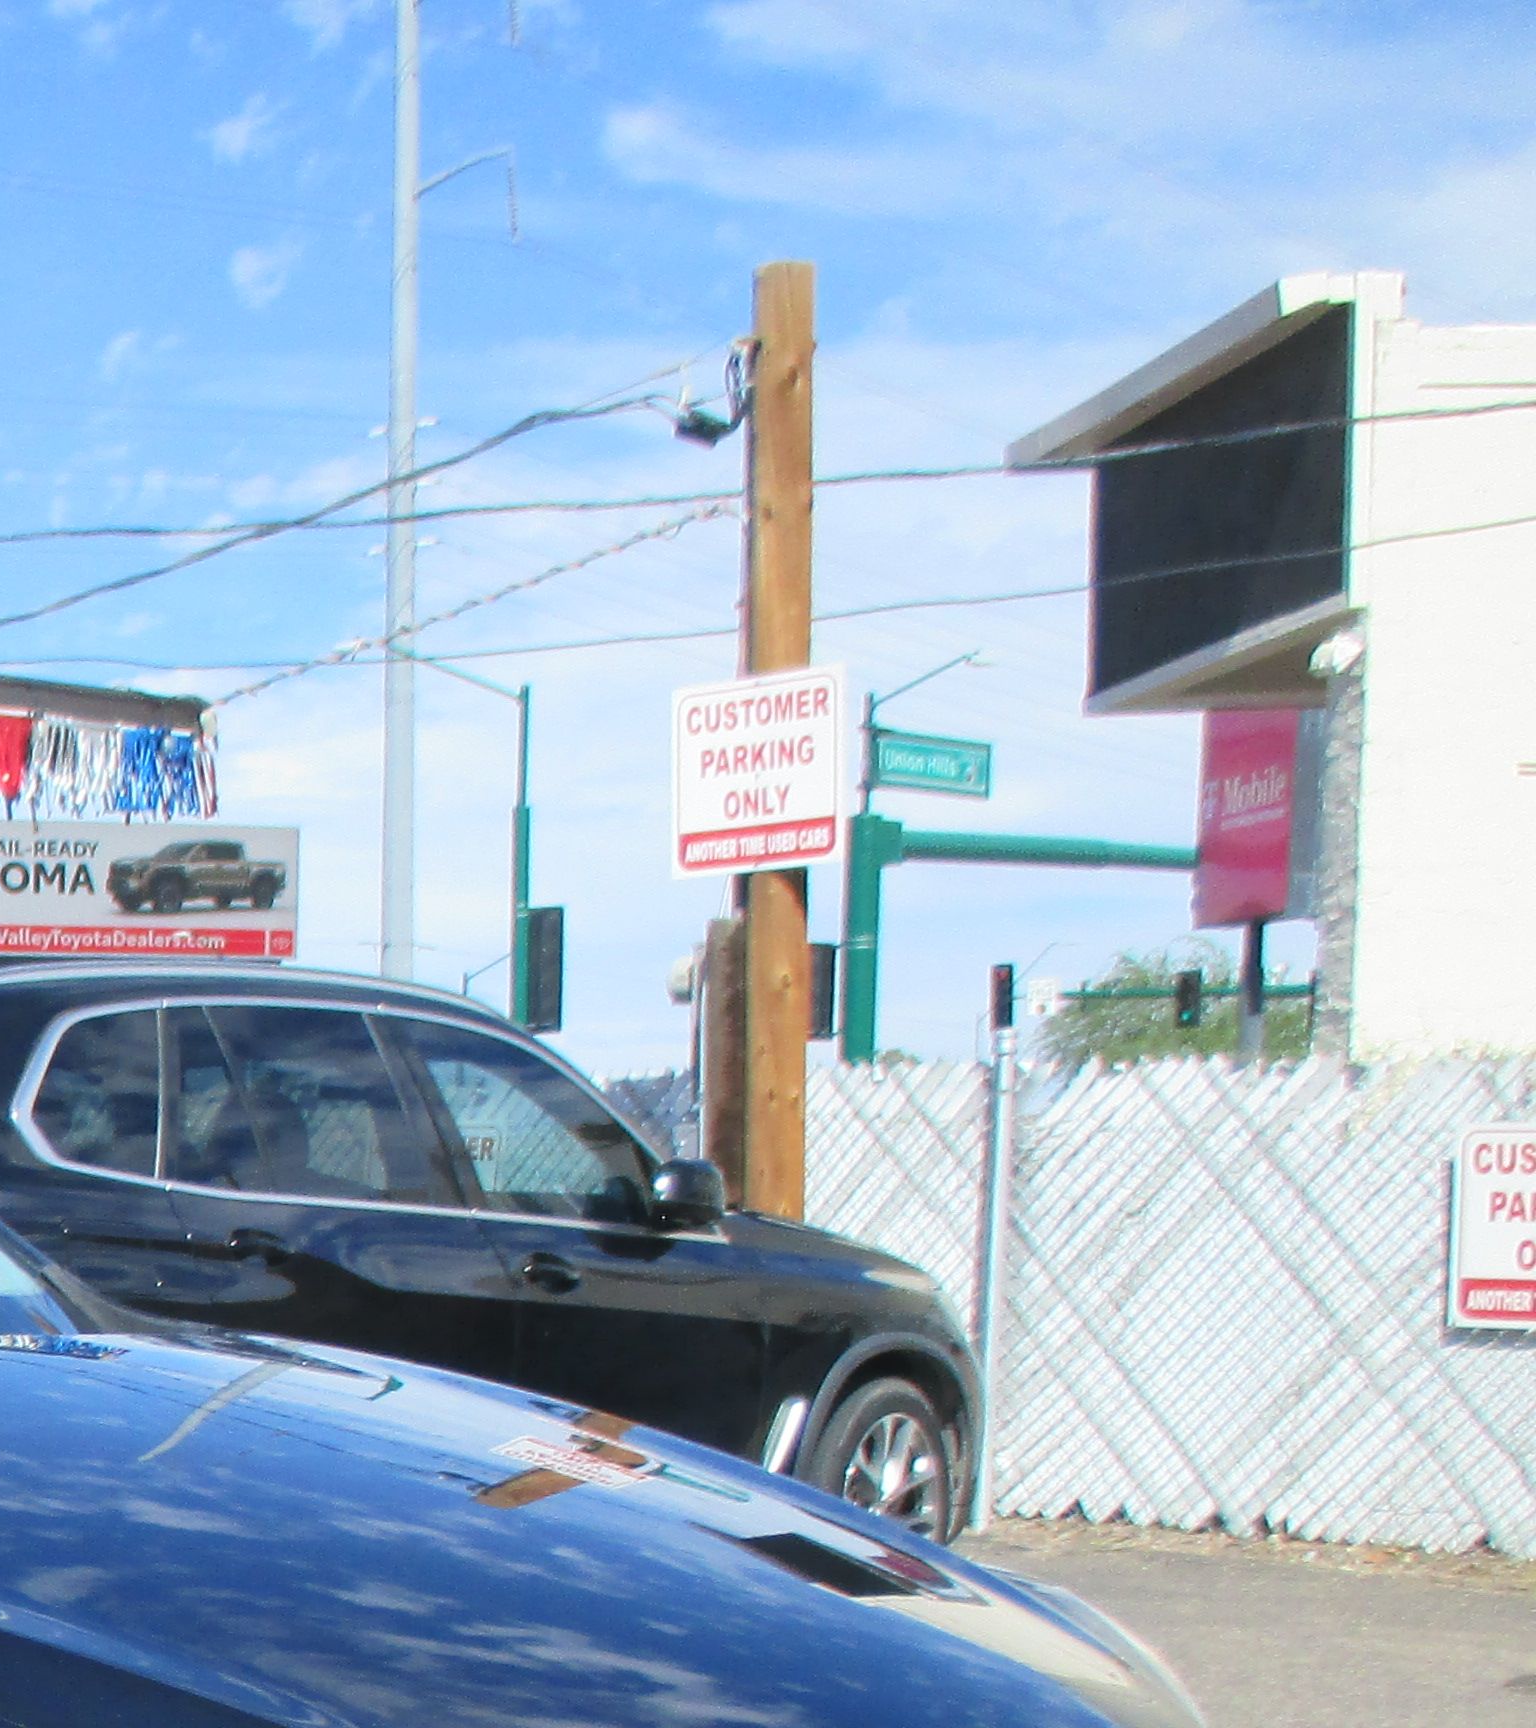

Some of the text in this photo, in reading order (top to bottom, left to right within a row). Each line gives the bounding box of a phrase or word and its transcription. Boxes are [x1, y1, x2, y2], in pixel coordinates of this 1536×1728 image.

[686, 687, 830, 735] CUSTOMER
[700, 735, 815, 779] PARKING
[723, 783, 791, 820] ONLY
[685, 826, 830, 863] ANOTHER TIME USED CARS
[1464, 1289, 1534, 1312] ANOTHER
